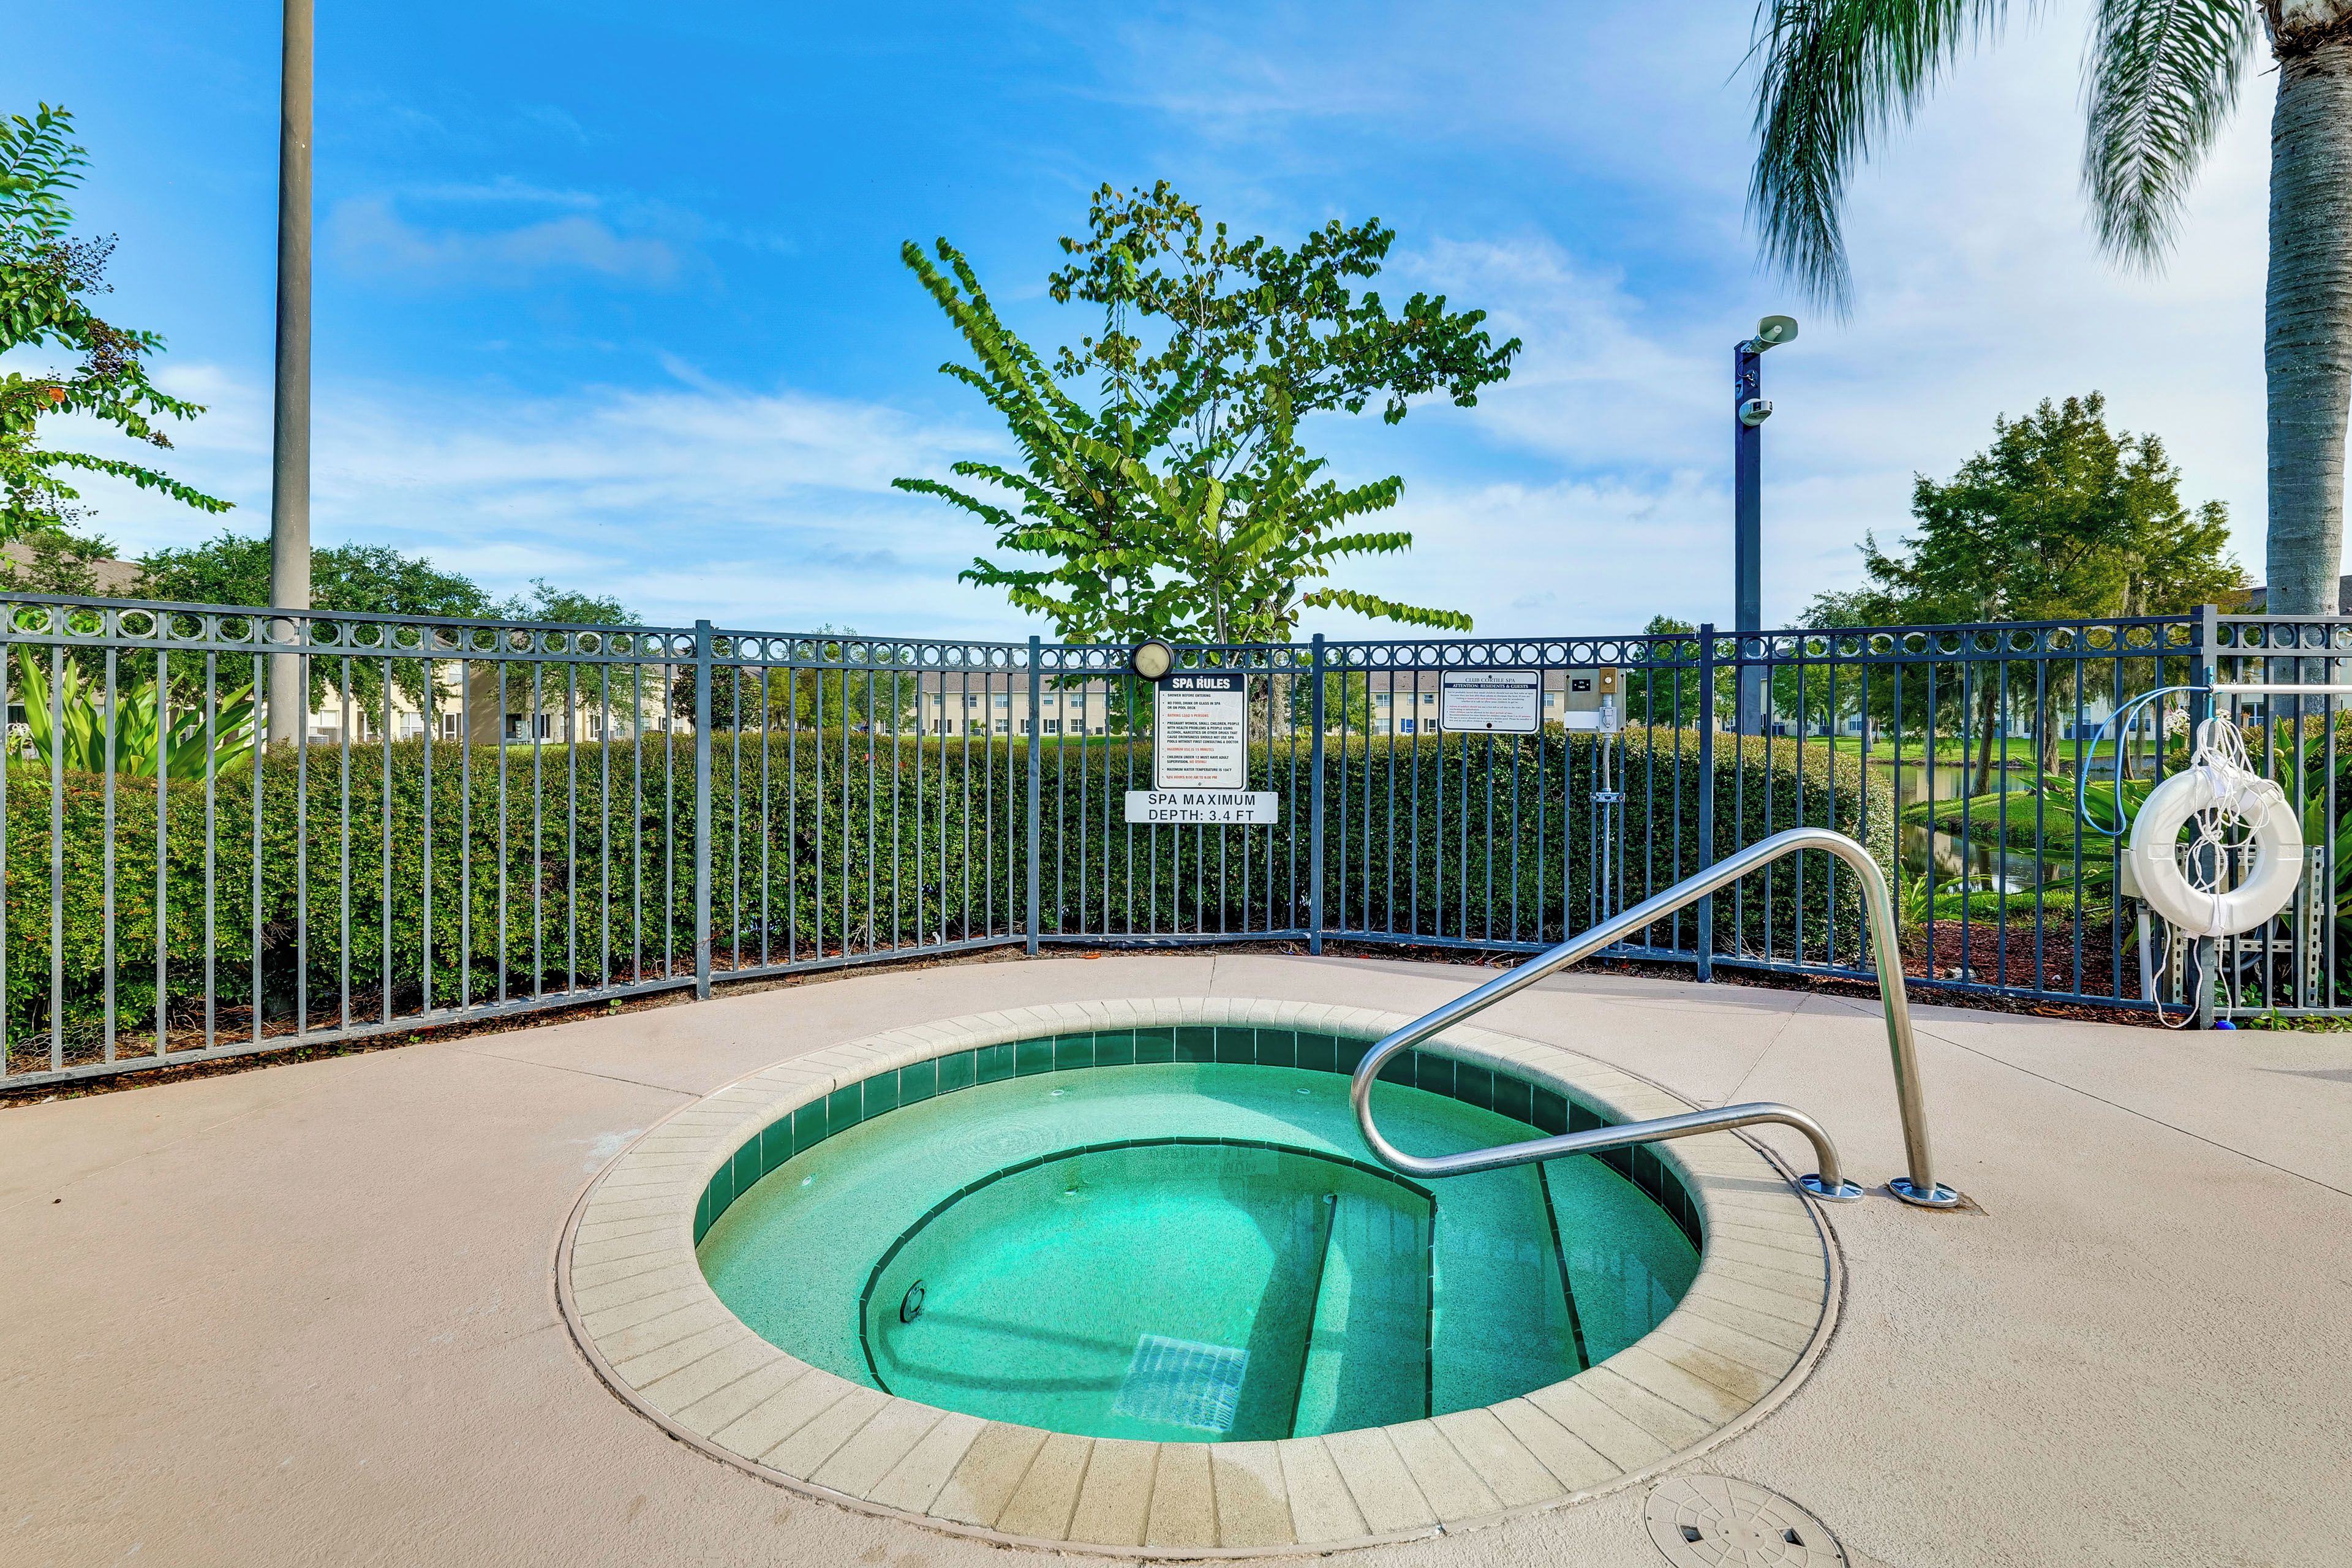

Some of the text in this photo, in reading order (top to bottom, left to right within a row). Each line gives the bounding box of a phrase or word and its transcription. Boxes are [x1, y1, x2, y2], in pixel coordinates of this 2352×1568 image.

[1173, 678, 1230, 688] SPA RULES
[1148, 794, 1255, 805] SPA MAXIMUM
[1149, 810, 1254, 821] DEPTH: 3.4 FT
